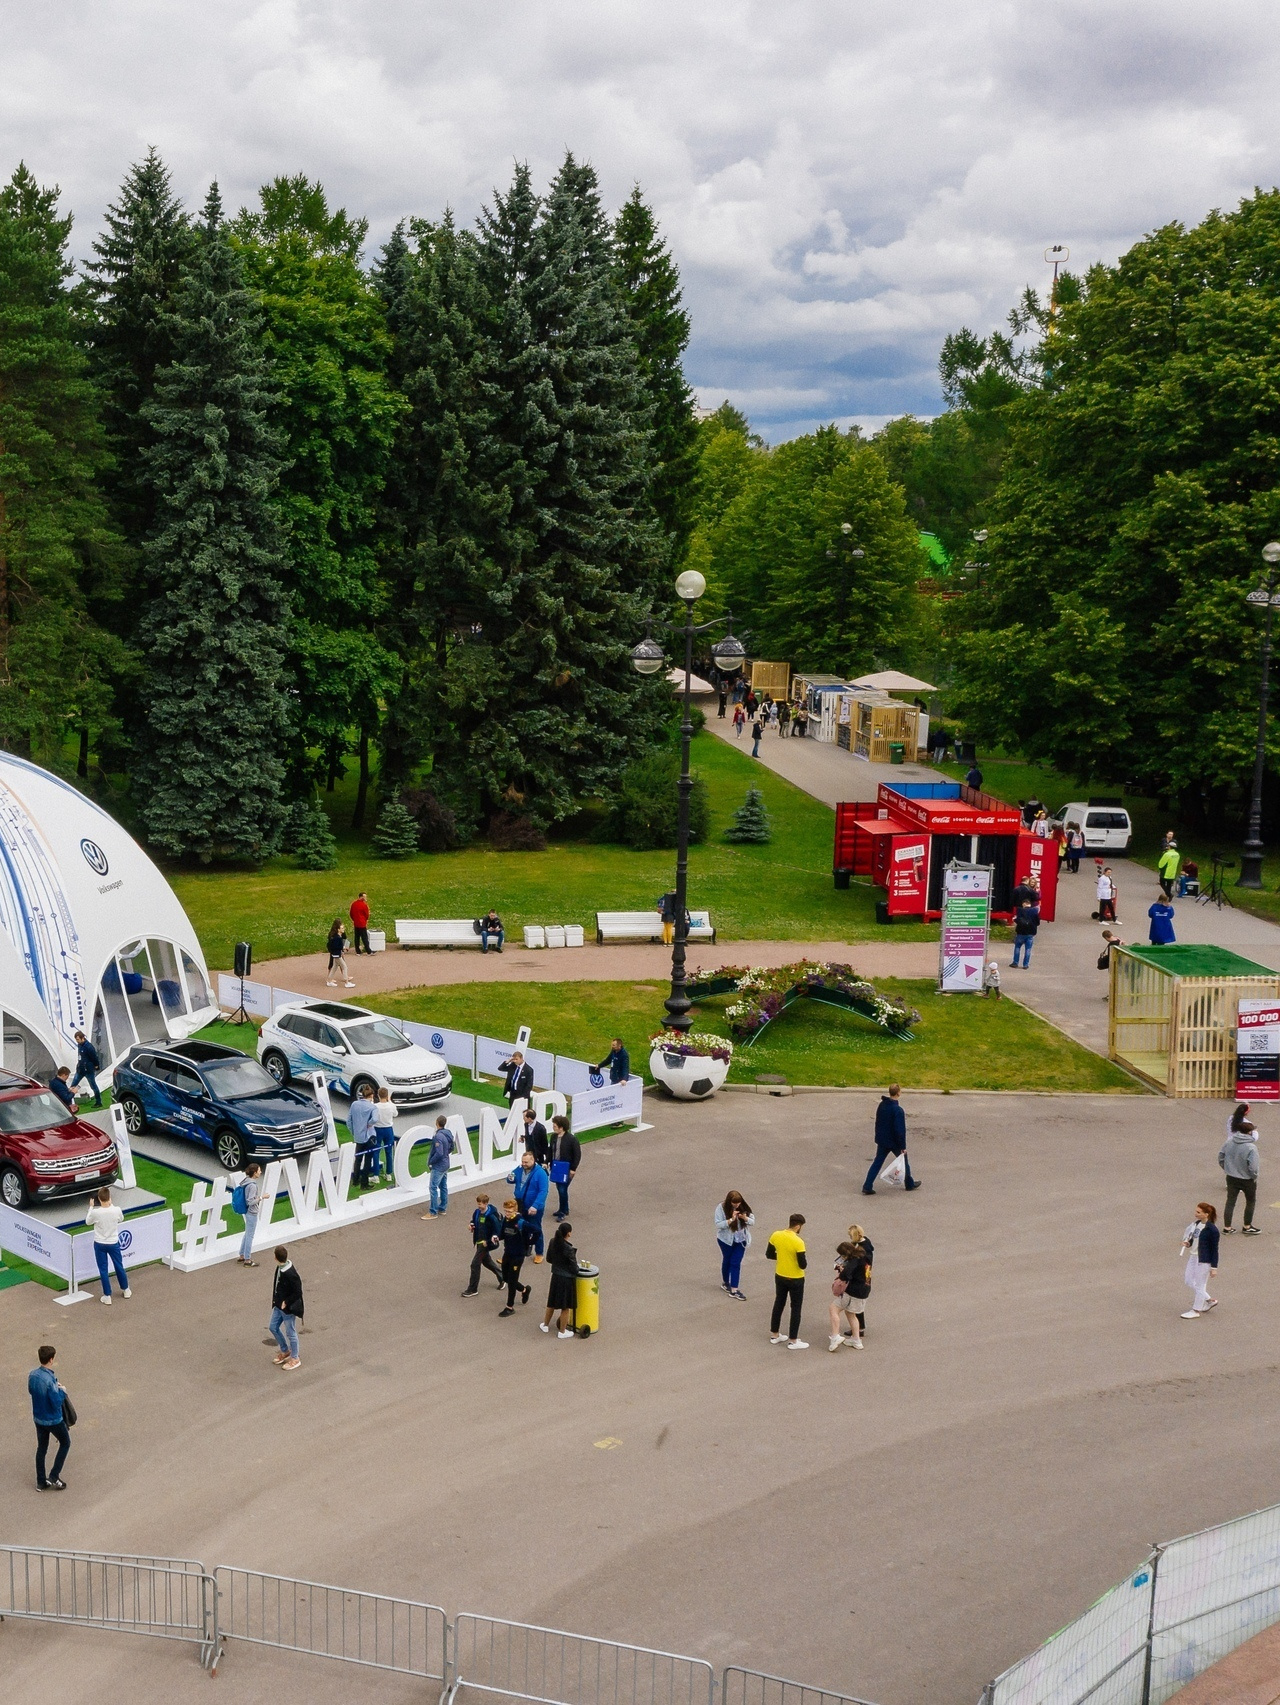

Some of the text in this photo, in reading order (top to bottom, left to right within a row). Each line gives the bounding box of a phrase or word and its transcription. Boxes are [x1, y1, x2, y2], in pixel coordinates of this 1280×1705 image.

[1241, 1015, 1258, 1025] 100
[1259, 1012, 1279, 1022] 000
[590, 1095, 615, 1105] VOLKSWAGEN
[600, 1103, 623, 1113] EXPERIENCE
[14, 1222, 42, 1240] VOLKSWAGEN
[27, 1235, 42, 1247] DIGITAL
[27, 1242, 51, 1258] EXPERIENCE
